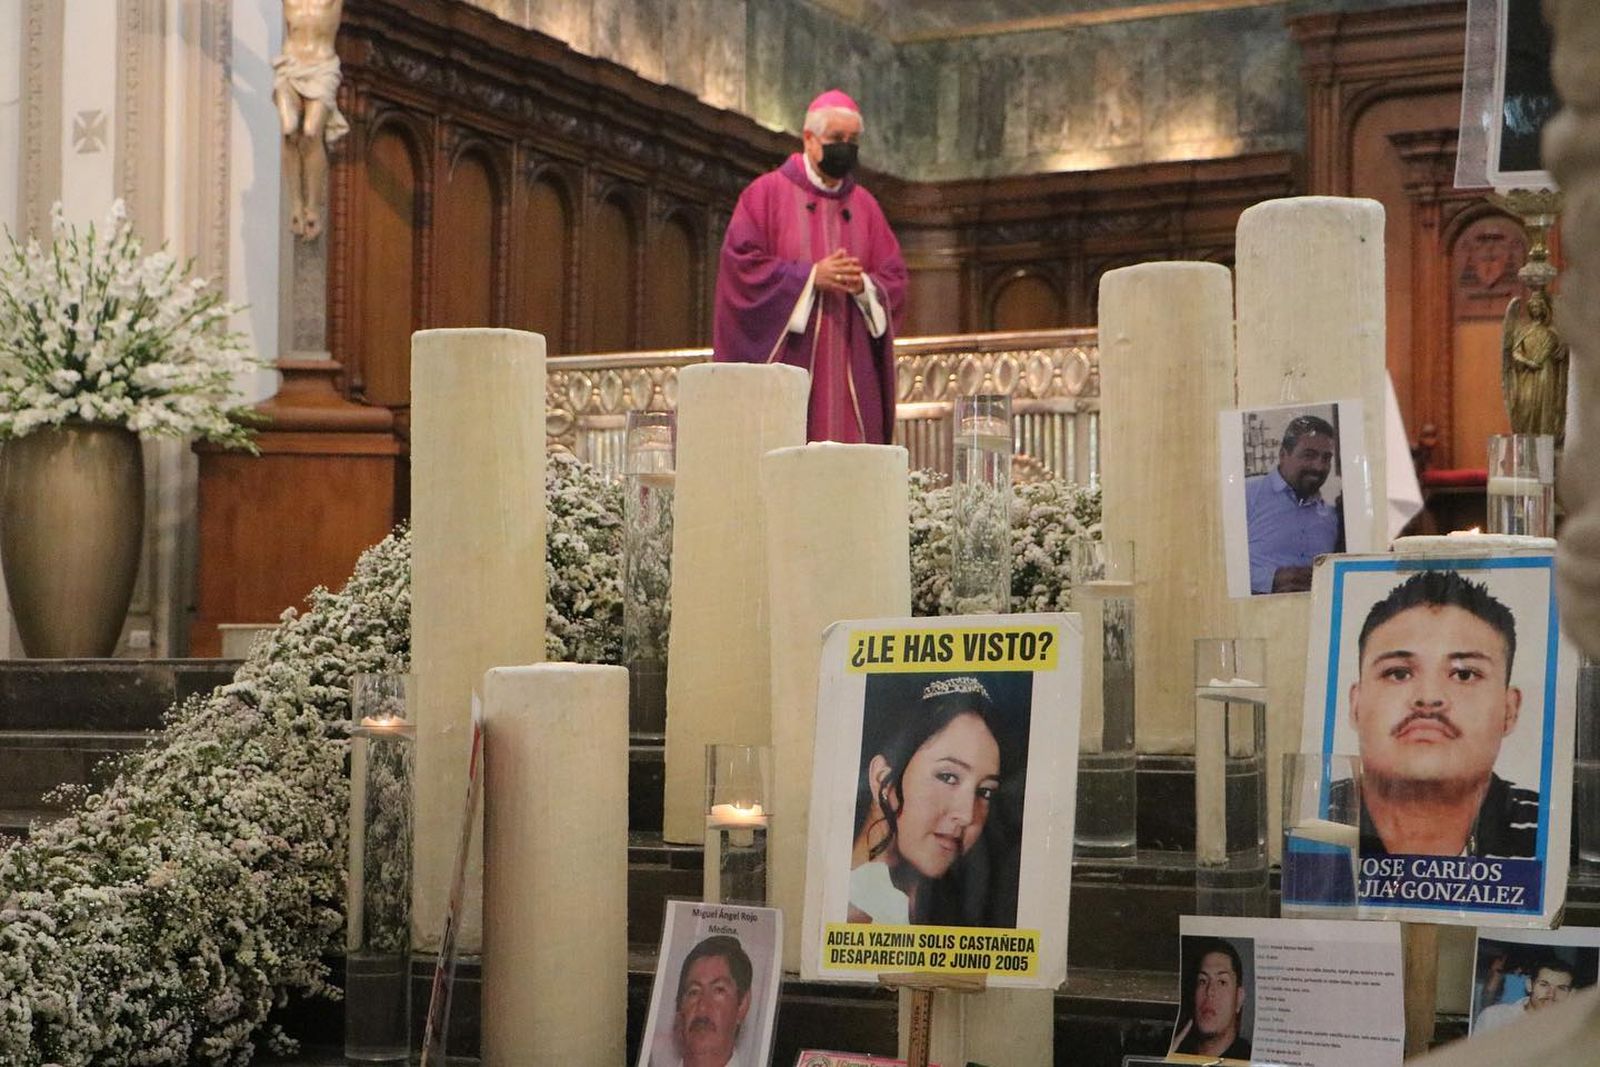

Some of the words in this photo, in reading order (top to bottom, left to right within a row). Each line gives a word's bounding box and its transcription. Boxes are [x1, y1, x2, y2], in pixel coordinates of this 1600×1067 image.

[851, 635, 895, 668] ¿LE
[903, 633, 954, 663] HAS
[963, 631, 1054, 662] VISTO?
[1411, 859, 1503, 882] CARLOS
[1401, 880, 1526, 906] GONZALEZ
[692, 908, 718, 920] Miguel
[719, 908, 740, 921] Ángel
[741, 912, 758, 923] Rojo
[827, 931, 865, 947] ADELA
[869, 933, 916, 948] YAZMIN
[918, 934, 956, 949] SOLIS
[959, 933, 1035, 953] CASTAÑEDA
[830, 949, 925, 967] DESAPARECIDA
[930, 952, 945, 968] 02
[950, 953, 991, 970] JUNIO
[995, 955, 1029, 971] 2005
